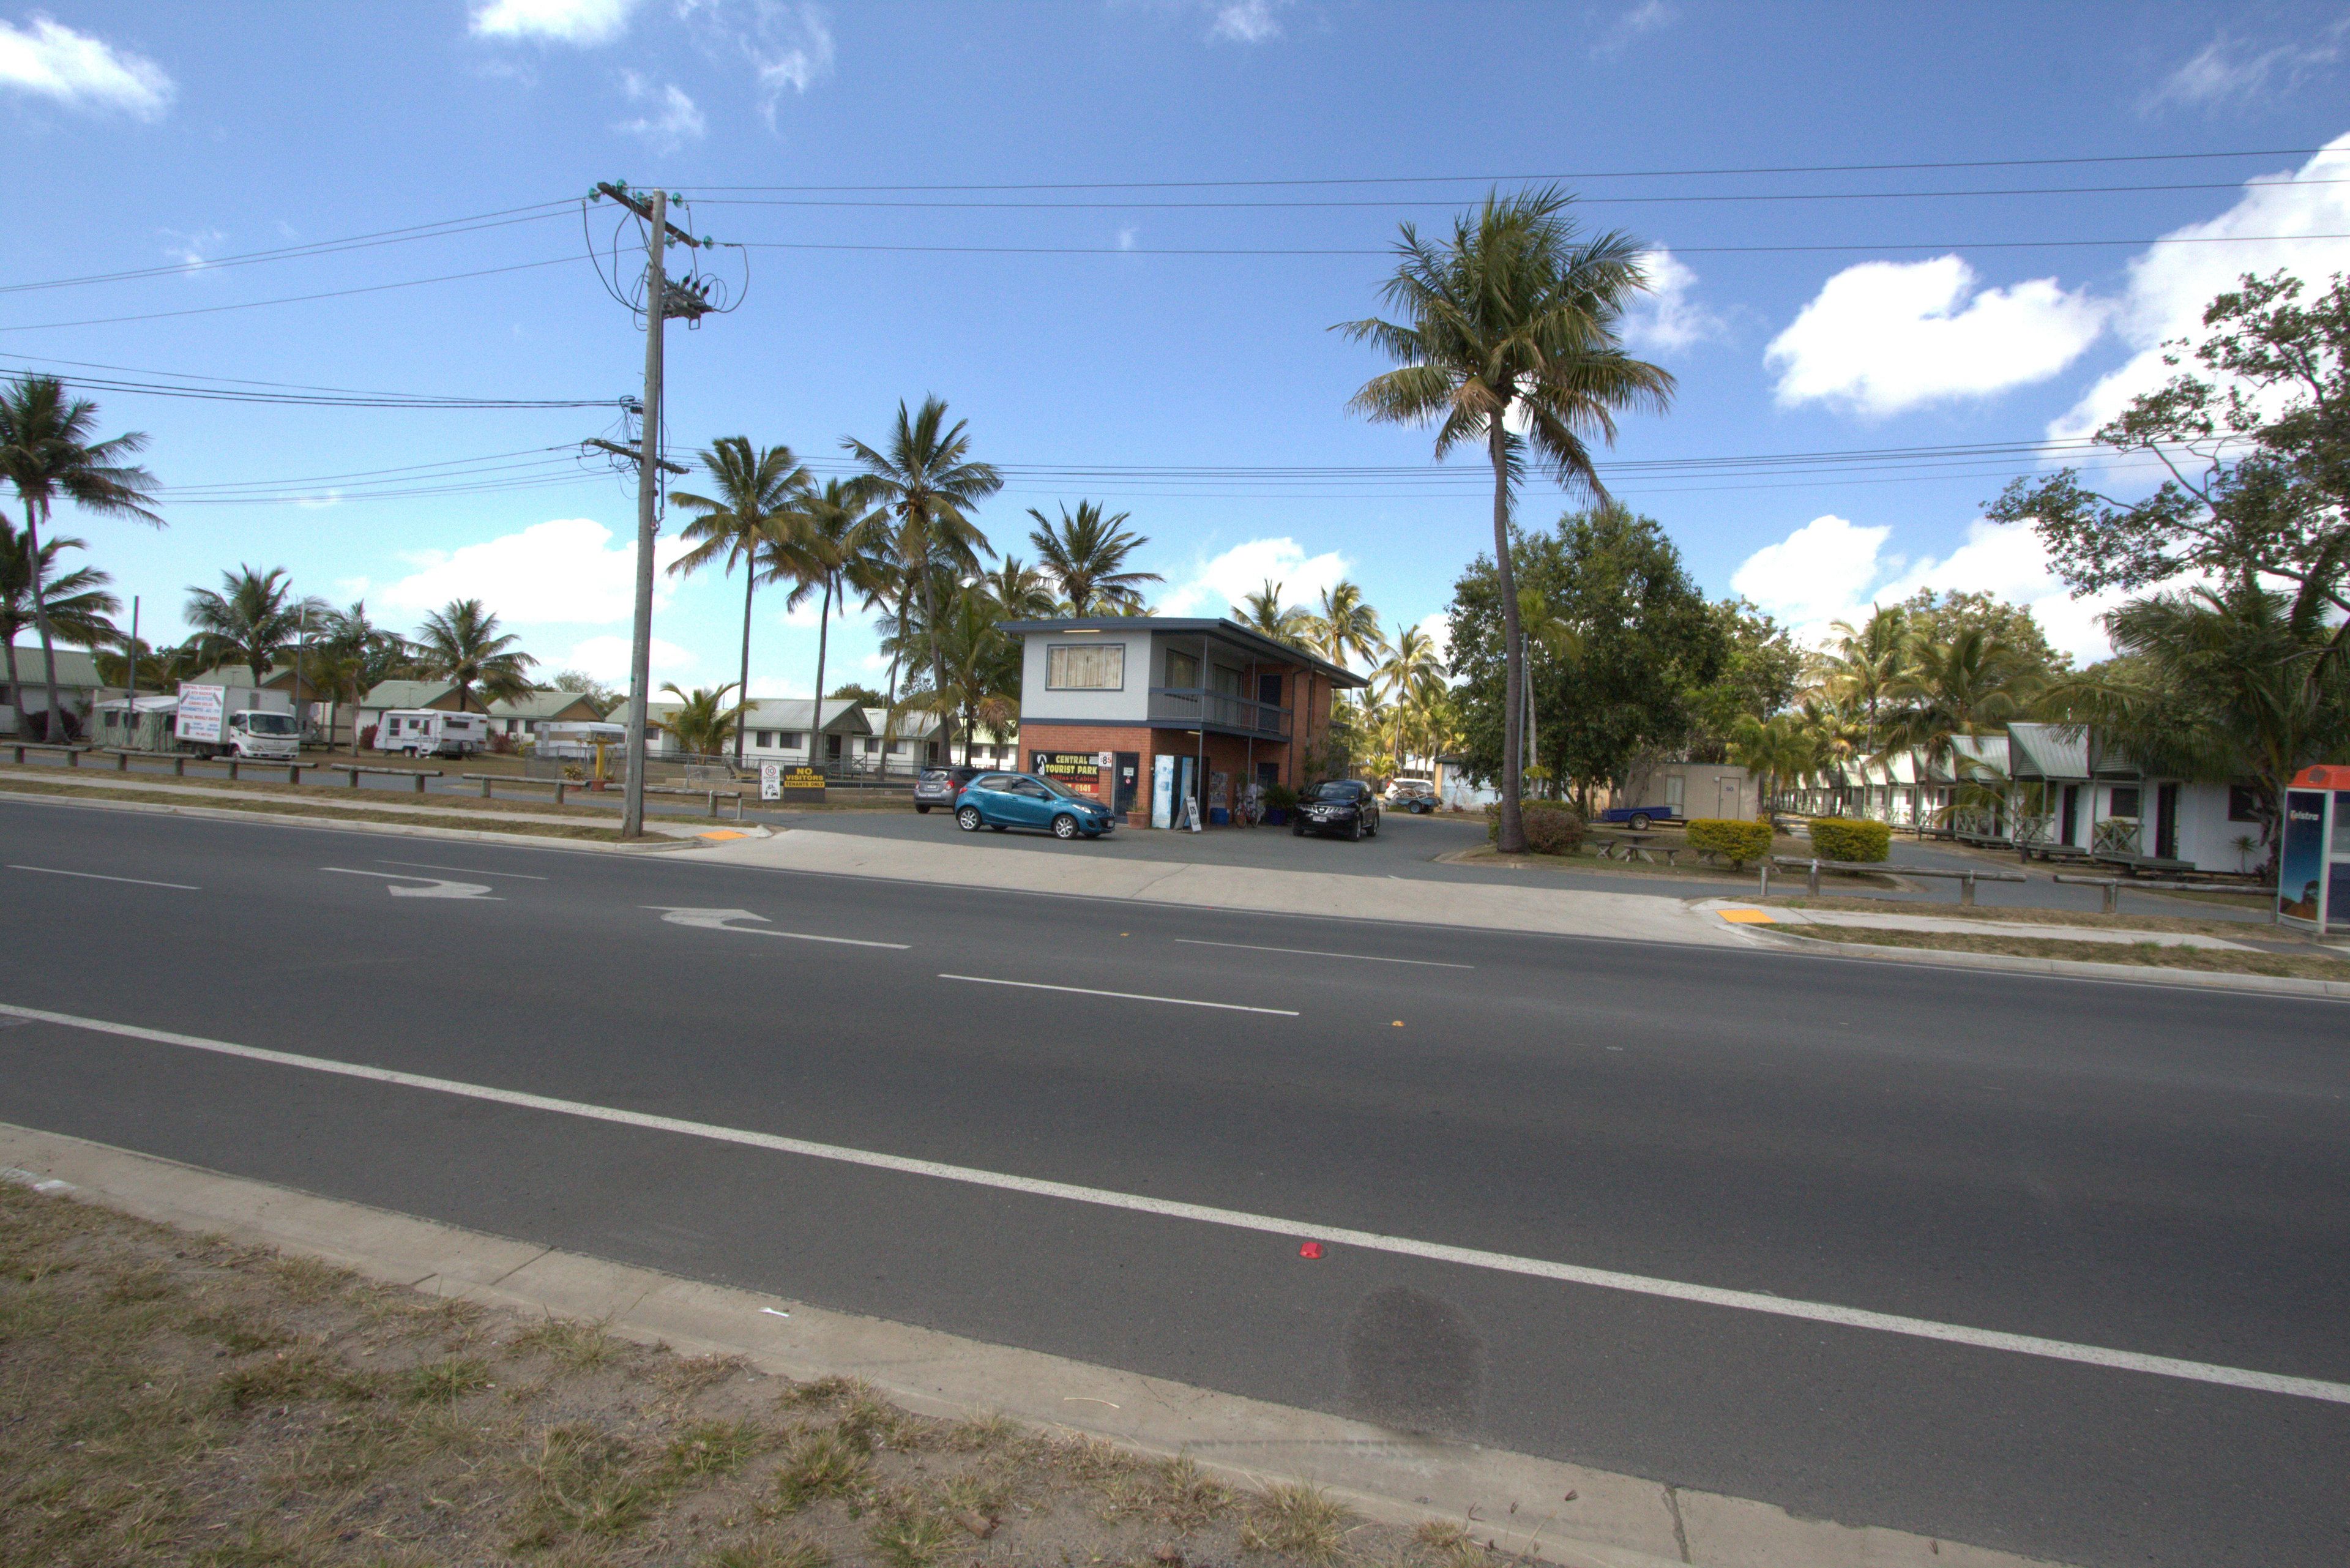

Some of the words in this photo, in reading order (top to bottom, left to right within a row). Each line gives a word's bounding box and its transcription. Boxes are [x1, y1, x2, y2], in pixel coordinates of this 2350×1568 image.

[1056, 755, 1087, 764] CENTRAL
[1045, 764, 1075, 774] TOURIST
[1077, 766, 1097, 775] PARK
[1075, 783, 1091, 792] 6141
[2289, 810, 2319, 821] Telstra
